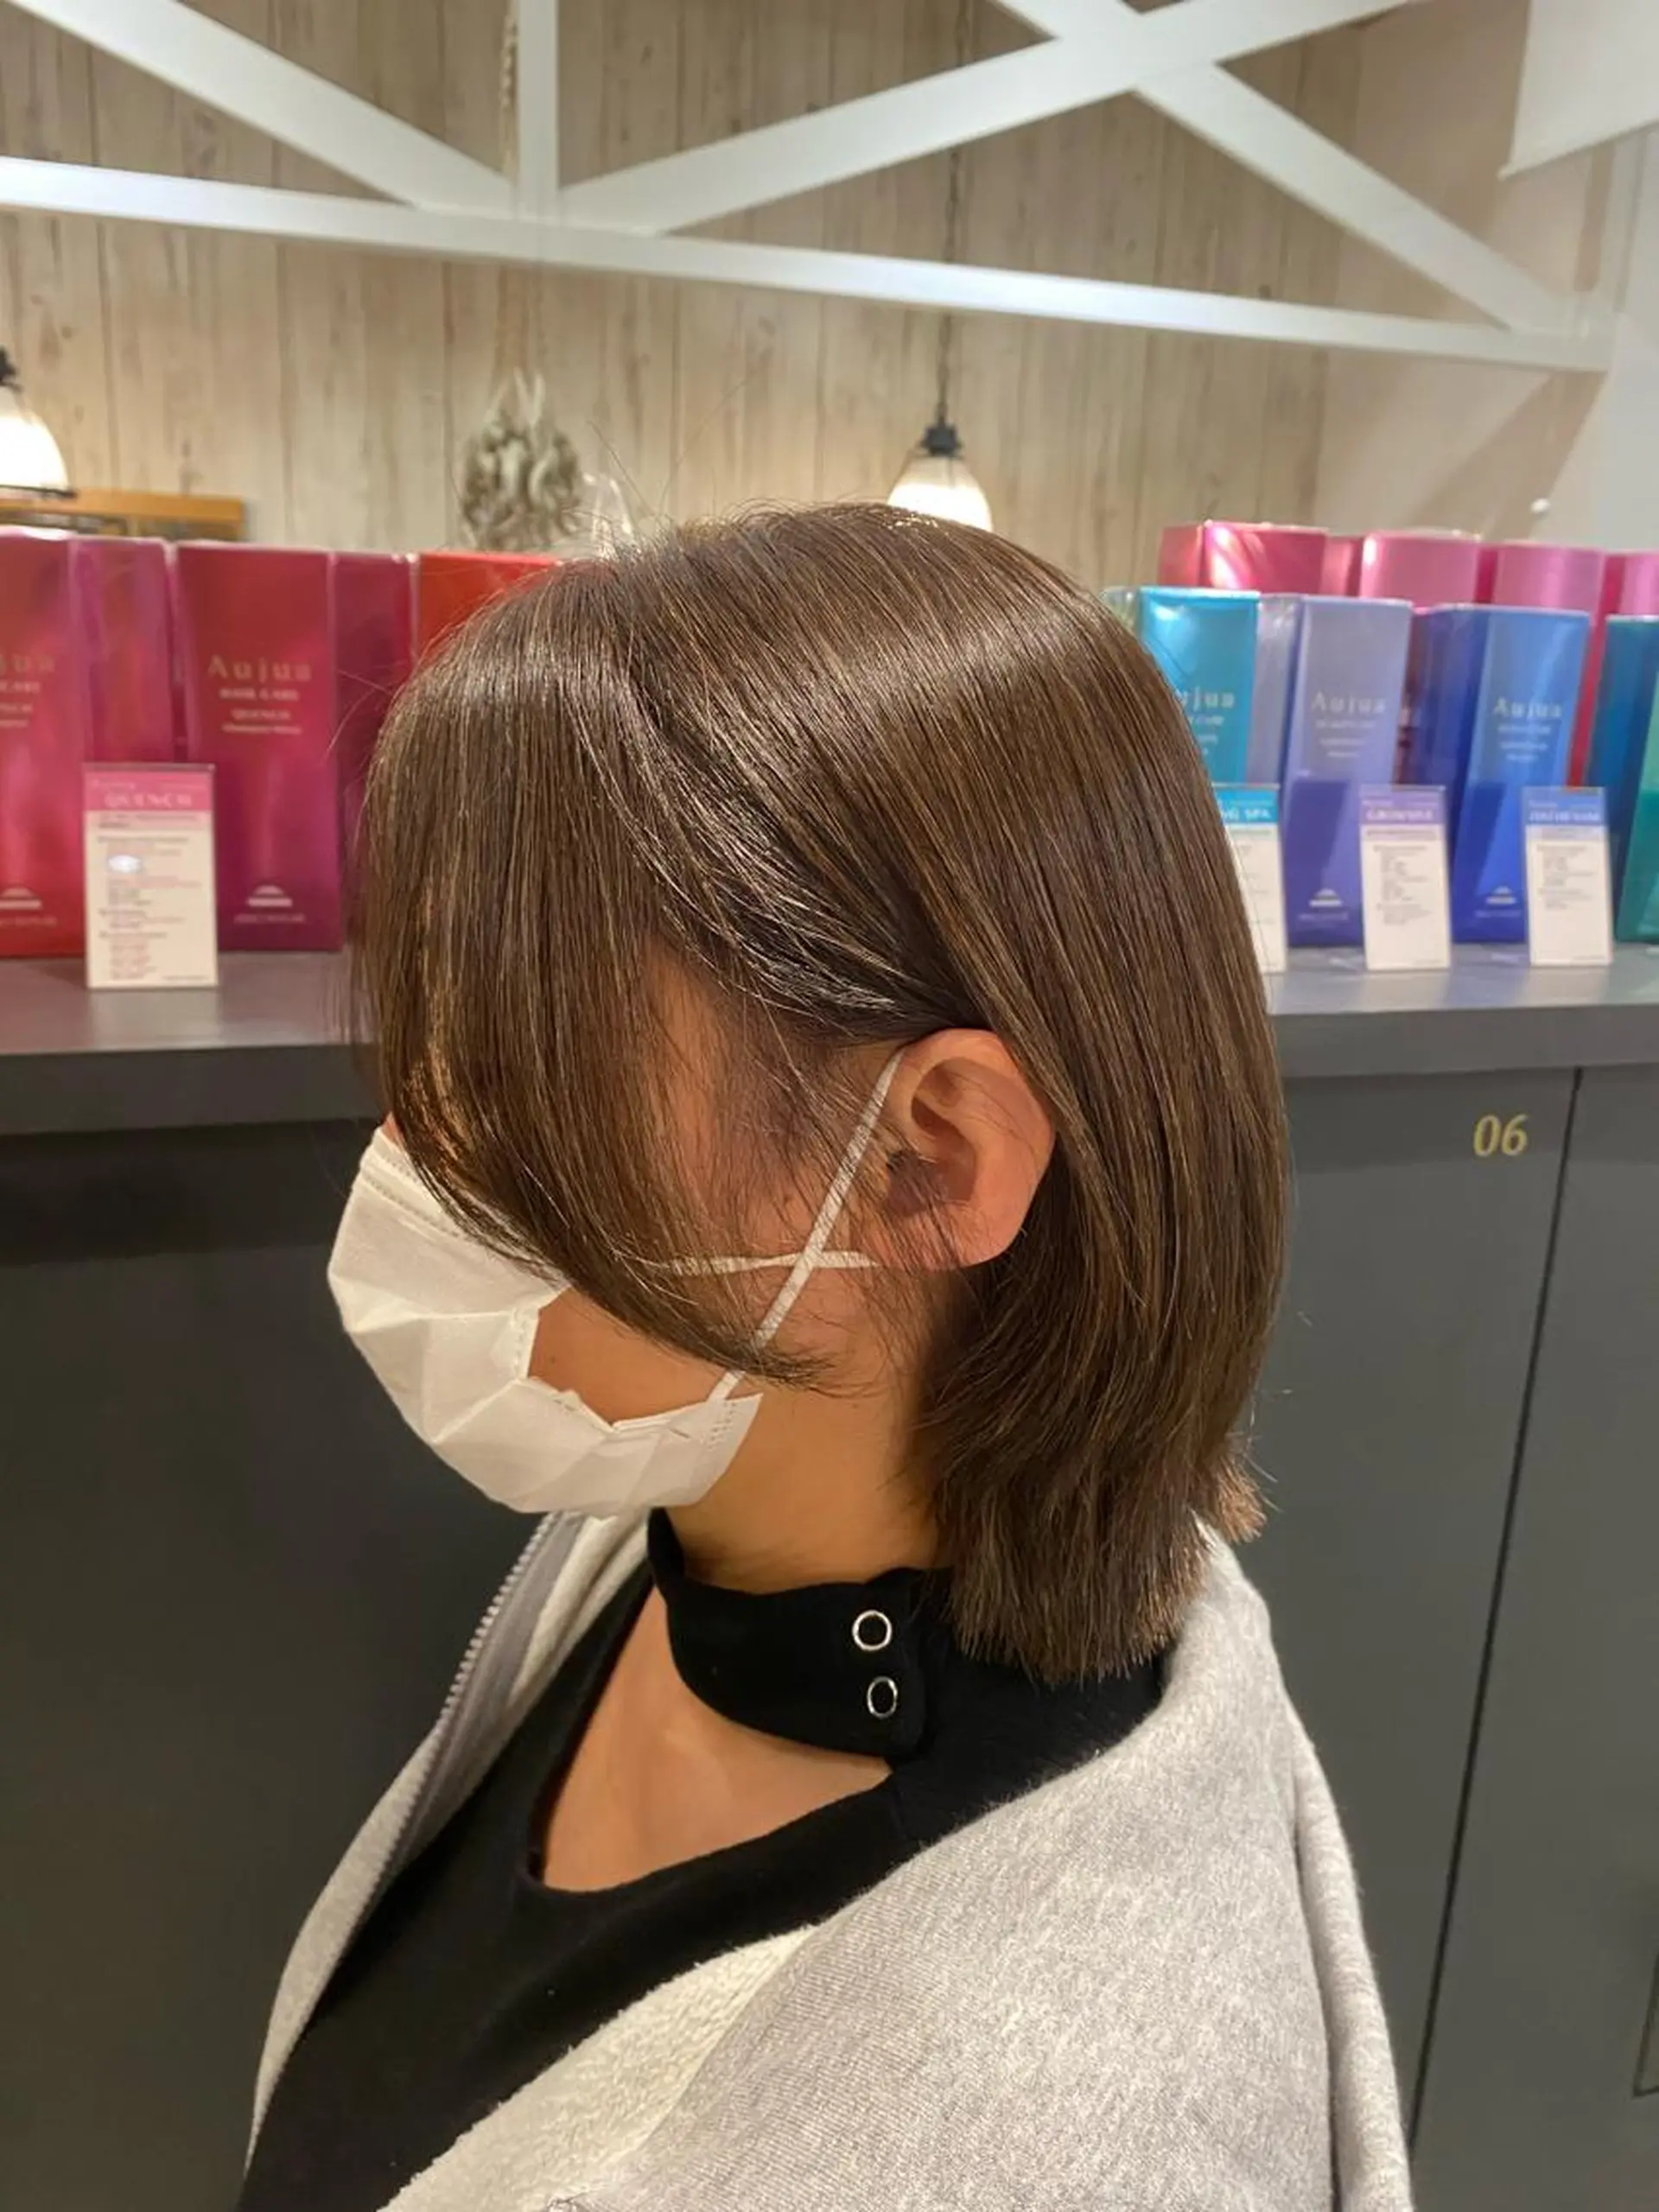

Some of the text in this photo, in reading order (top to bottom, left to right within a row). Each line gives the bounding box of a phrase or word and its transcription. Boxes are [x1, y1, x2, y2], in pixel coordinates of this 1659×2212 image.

[208, 654, 311, 683] Aujua
[1492, 696, 1561, 721] Aujua
[1473, 1113, 1528, 1156] 06
